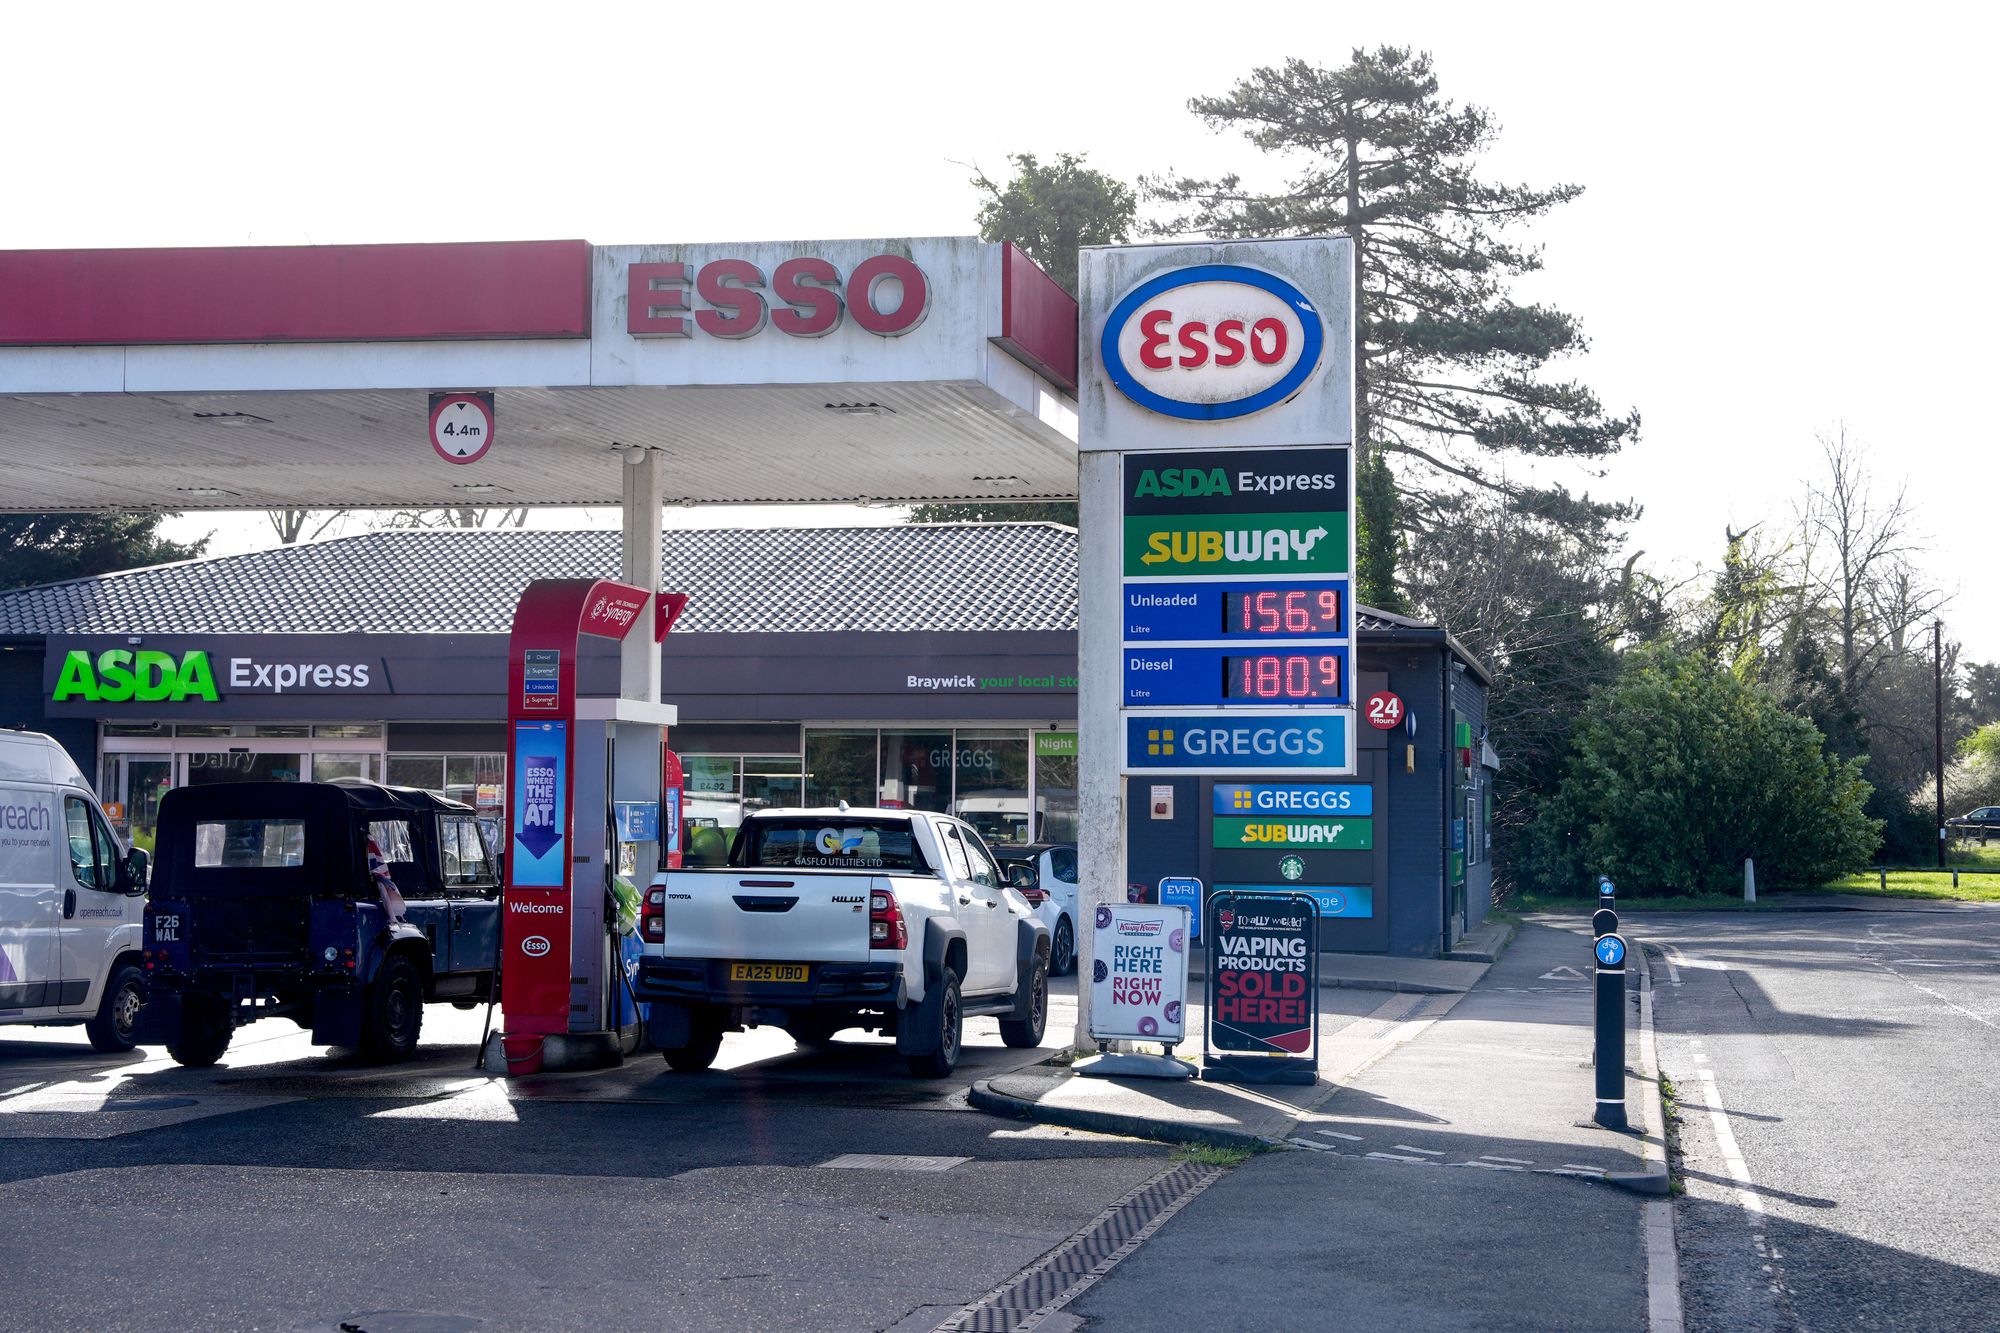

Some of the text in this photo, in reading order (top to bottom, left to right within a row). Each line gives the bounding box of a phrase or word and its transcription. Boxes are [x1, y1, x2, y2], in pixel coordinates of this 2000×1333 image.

[627, 254, 932, 340] ESSO
[443, 421, 481, 437] 4.4m
[1134, 468, 1336, 498] ASDA Express
[1140, 526, 1329, 566] SUBWAY
[602, 602, 635, 627] Synergy
[662, 604, 669, 618] 1
[1130, 591, 1337, 632] Unleaded 156.9
[1130, 625, 1150, 634] Litre
[52, 649, 370, 702] ASDA Express
[907, 675, 976, 690] Braywick
[980, 677, 1014, 690] your
[1018, 675, 1054, 687] local
[1130, 656, 1337, 698] Diesel 180.9
[1130, 690, 1150, 698] Litre
[1370, 697, 1400, 718] 24
[1039, 738, 1073, 751] Night
[1183, 728, 1324, 756] GREGGS
[929, 749, 993, 768] GREGGS
[527, 777, 553, 785] WHERE
[527, 785, 553, 798] THE
[1257, 790, 1351, 809] GREGGS
[525, 803, 554, 826] AT.
[1241, 824, 1344, 843] SUBWAY
[1, 838, 10, 848] you
[11, 837, 18, 846] to
[18, 838, 30, 848] your
[794, 856, 883, 867] GASFLO UTILITIES LTD
[80, 906, 123, 918] openreach.co.uk
[510, 901, 564, 914] Welcome
[155, 915, 179, 928] F26
[1120, 923, 1160, 932] Krispy Kreme
[155, 929, 179, 942] WAL
[526, 940, 547, 950] Esso
[1114, 945, 1163, 959] RIGHT
[1219, 935, 1307, 957] VAPING
[1113, 958, 1162, 974] HERE
[1218, 956, 1306, 972] PRODUCTS
[736, 966, 803, 980] EA25 UBO
[1113, 977, 1162, 991] RIGHT
[1218, 971, 1306, 998] SOLD
[1113, 989, 1162, 1006] NOW
[1217, 997, 1306, 1024] HERE!
